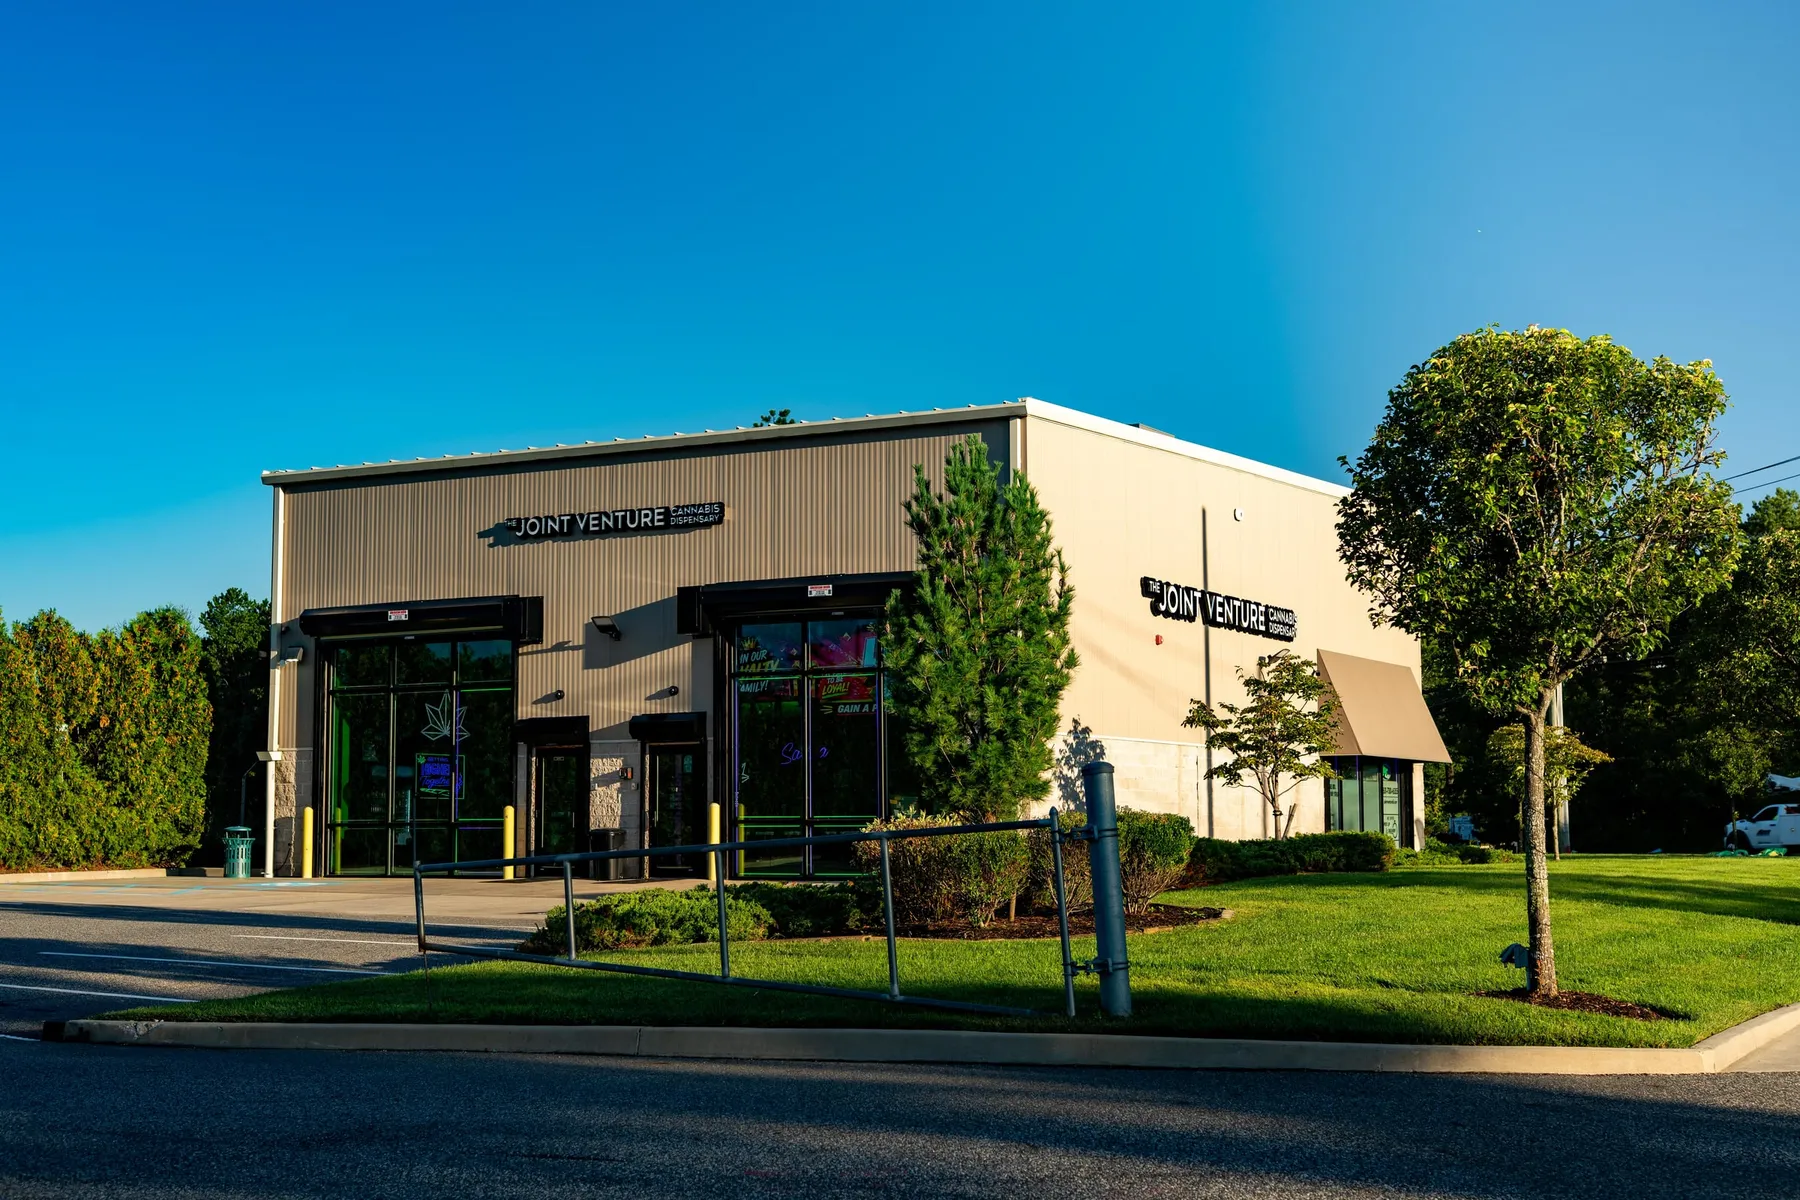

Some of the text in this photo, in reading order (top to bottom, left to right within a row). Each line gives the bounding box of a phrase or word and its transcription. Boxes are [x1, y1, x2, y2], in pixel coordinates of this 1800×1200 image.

[670, 504, 720, 516] CANNABIS
[504, 519, 517, 528] THE
[516, 508, 665, 537] JOINT VENTURE
[670, 514, 720, 525] DISPENSARY
[1149, 580, 1161, 593] THE
[1160, 584, 1266, 631] JOINT VENTURE
[1268, 608, 1297, 626] CANNABIS
[739, 650, 768, 664] IN OUR
[740, 680, 769, 693] AMILY!
[821, 682, 851, 696] LOYAL!
[837, 703, 861, 713] GAIN
[862, 703, 870, 713] A
[420, 763, 451, 776] HIGHE
